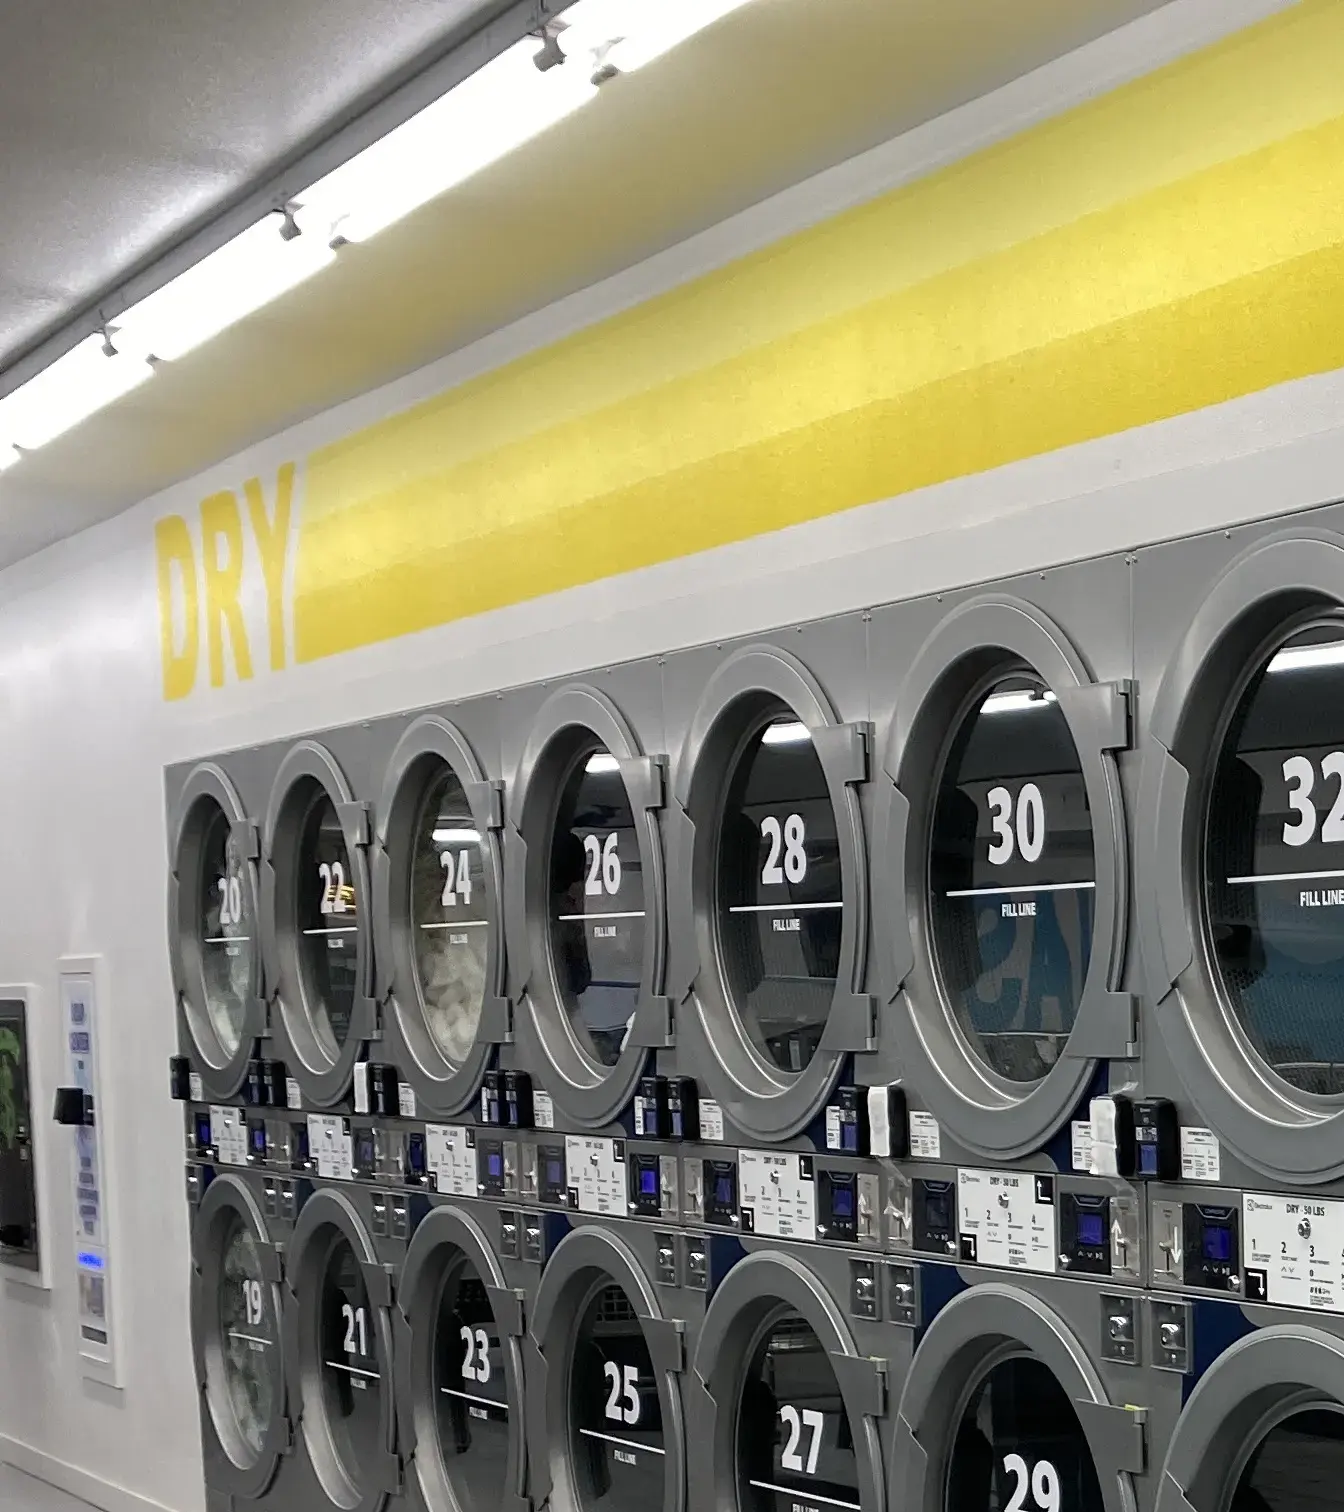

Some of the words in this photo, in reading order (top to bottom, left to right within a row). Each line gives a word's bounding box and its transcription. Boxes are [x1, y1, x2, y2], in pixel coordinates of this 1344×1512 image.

[155, 462, 296, 701] DRY
[760, 813, 807, 885] 28
[987, 783, 1045, 865] 30
[318, 861, 346, 914] 22
[440, 849, 472, 906] 24
[583, 832, 622, 896] 26
[218, 877, 241, 924] 20
[1002, 903, 1017, 917] FILL
[1018, 902, 1036, 916] LINE
[1300, 890, 1320, 907] FILL
[1322, 889, 1344, 905] LINE
[1286, 1204, 1299, 1214] DRY
[1313, 1206, 1325, 1216] LBS
[243, 1280, 262, 1324] 19
[342, 1303, 366, 1356] 21
[460, 1325, 490, 1383] 23
[604, 1361, 640, 1425] 25
[780, 1404, 824, 1474] 27
